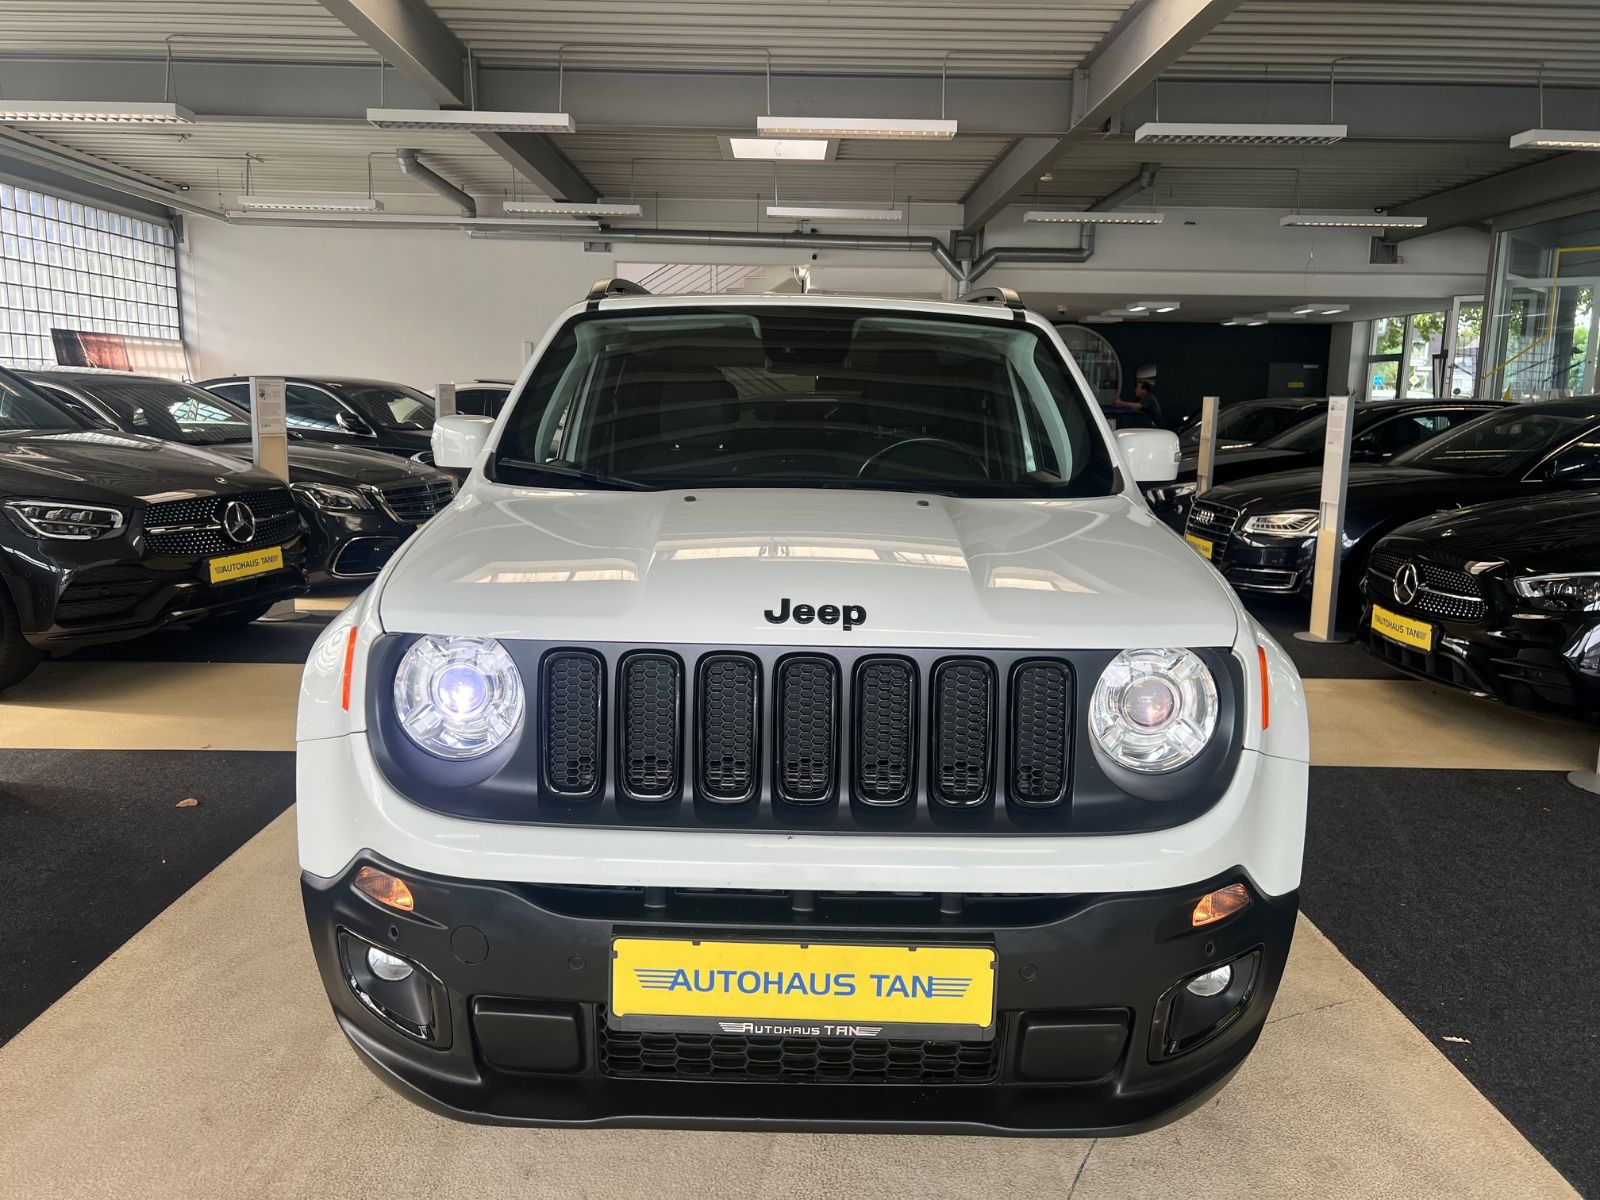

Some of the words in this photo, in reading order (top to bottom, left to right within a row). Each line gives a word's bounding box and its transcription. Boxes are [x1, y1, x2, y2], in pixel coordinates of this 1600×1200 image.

[222, 559, 259, 573] AUTOHAUS
[261, 556, 273, 564] TAN
[764, 598, 867, 631] Jeep
[1406, 627, 1419, 638] TAN
[668, 968, 856, 996] AUTOHAUS
[869, 974, 933, 998] TAN
[824, 1025, 859, 1036] TAN
